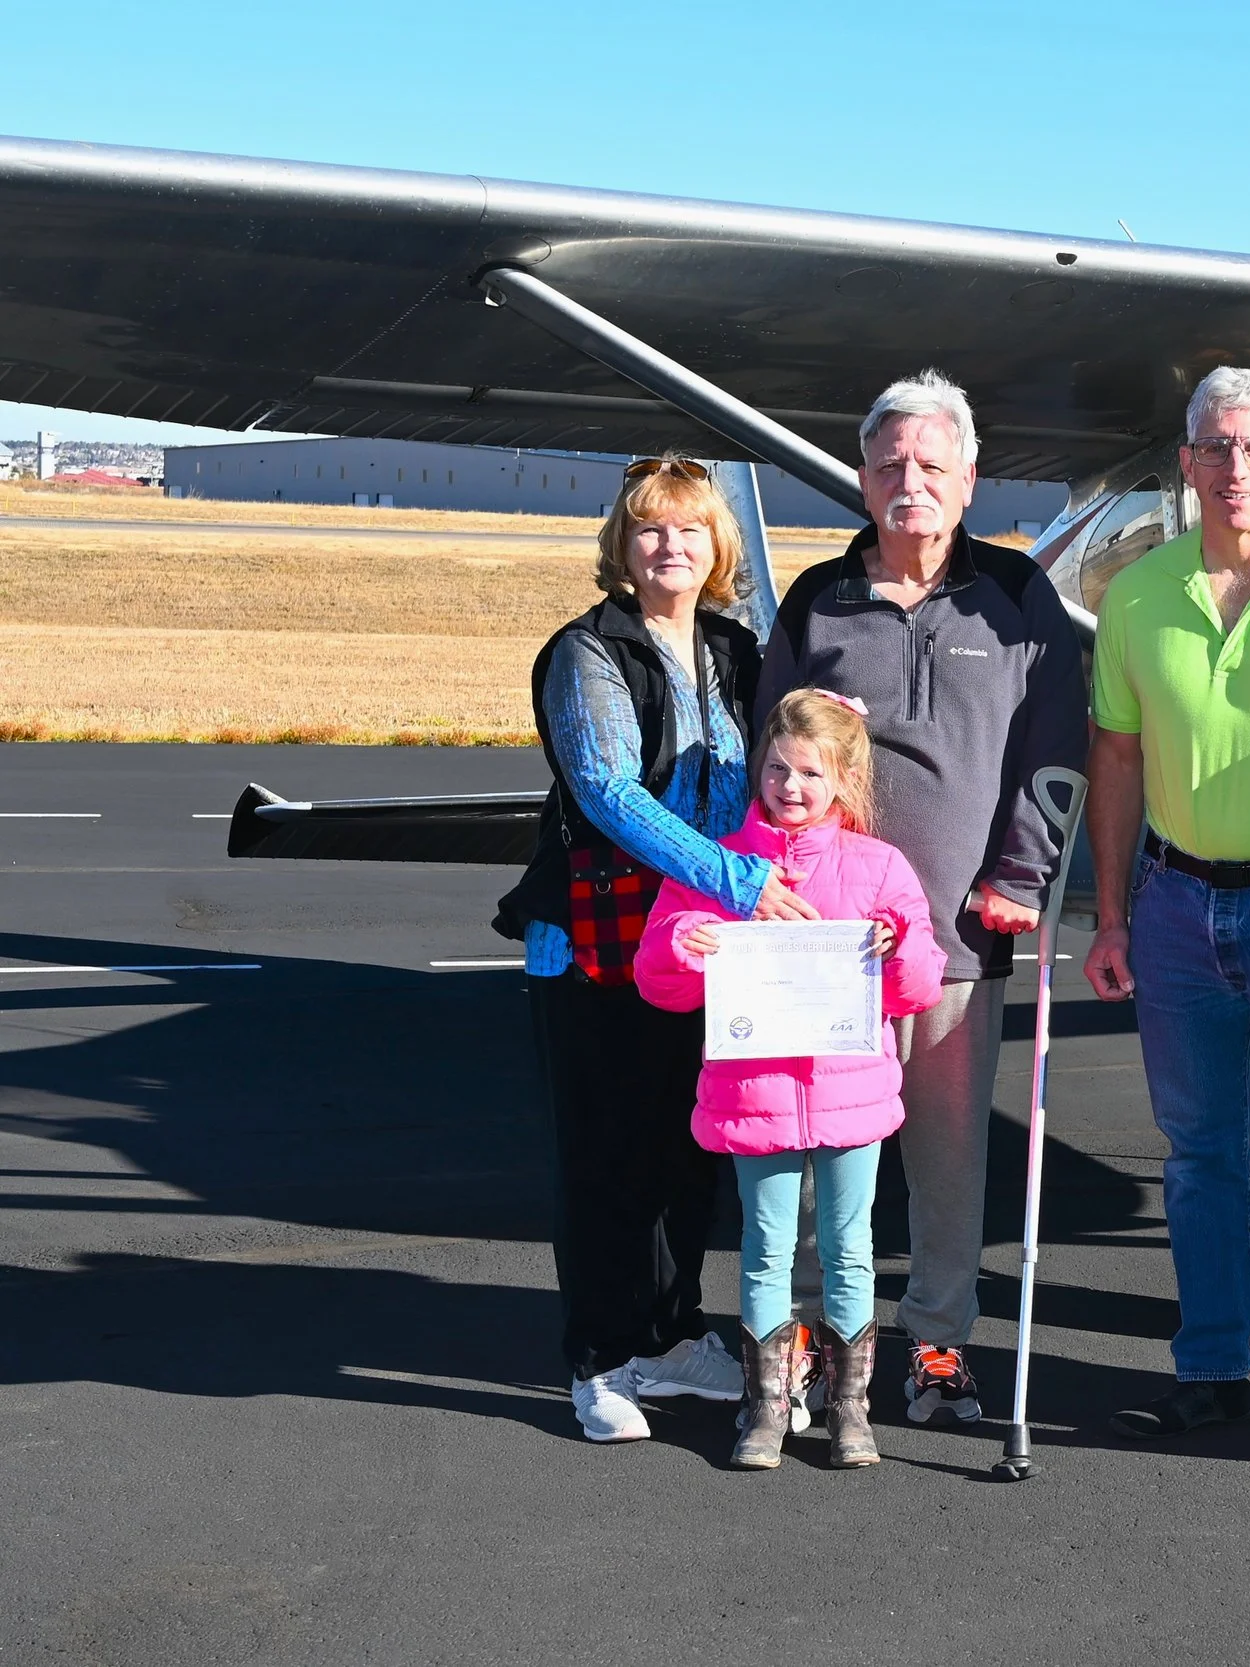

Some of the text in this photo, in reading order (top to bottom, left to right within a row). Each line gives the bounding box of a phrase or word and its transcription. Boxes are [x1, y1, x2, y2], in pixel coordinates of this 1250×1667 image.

[957, 647, 988, 657] Columbia
[728, 941, 859, 954] YOUN EAGLES CERTIFICATE
[830, 1023, 853, 1032] EAA
